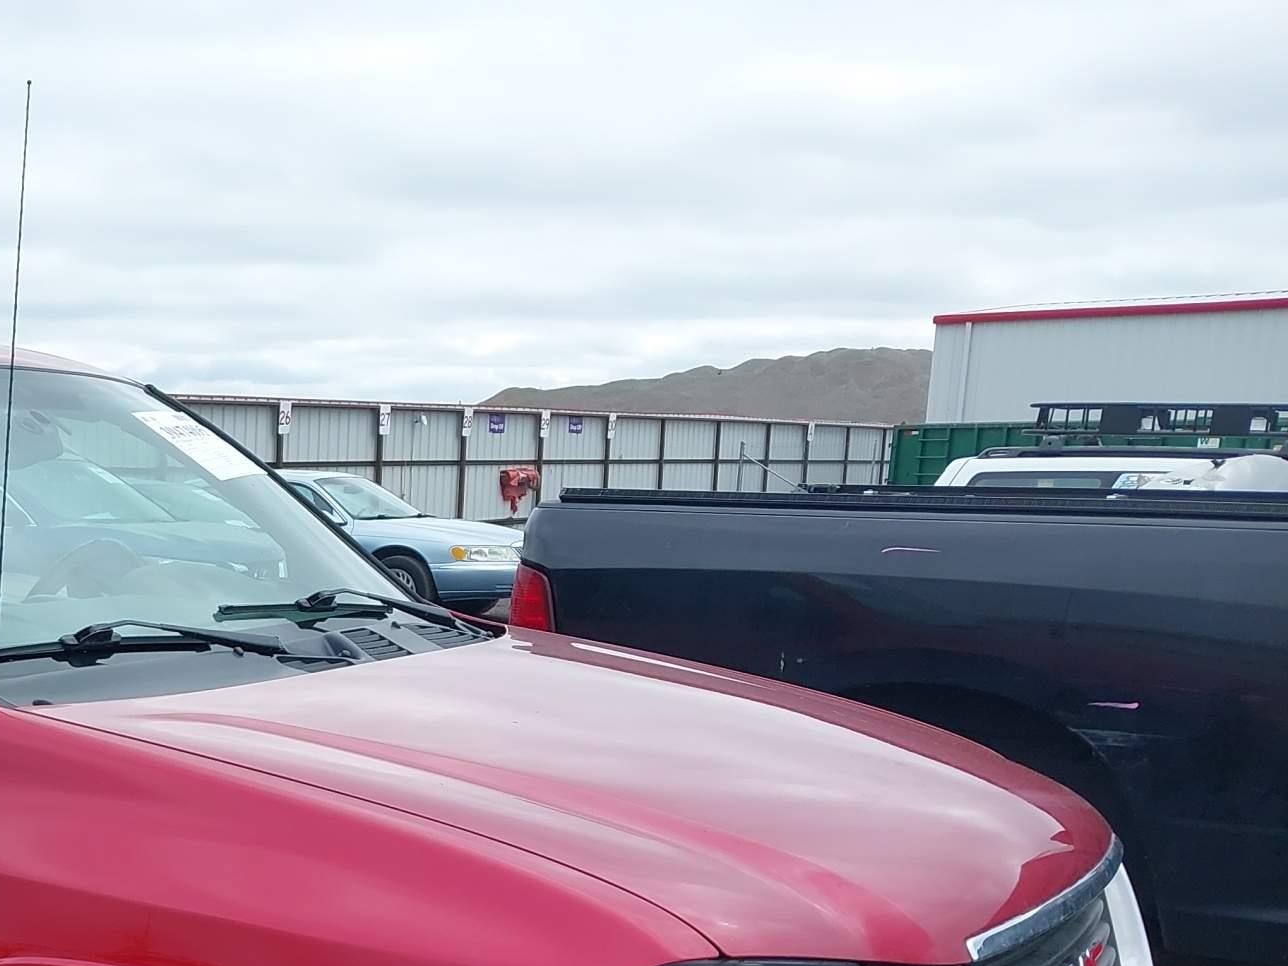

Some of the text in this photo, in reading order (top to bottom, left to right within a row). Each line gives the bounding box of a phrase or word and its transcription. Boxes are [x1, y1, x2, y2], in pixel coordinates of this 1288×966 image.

[279, 410, 291, 426] 26
[380, 413, 391, 427] 27
[462, 415, 473, 429] 28
[541, 418, 550, 430] 29
